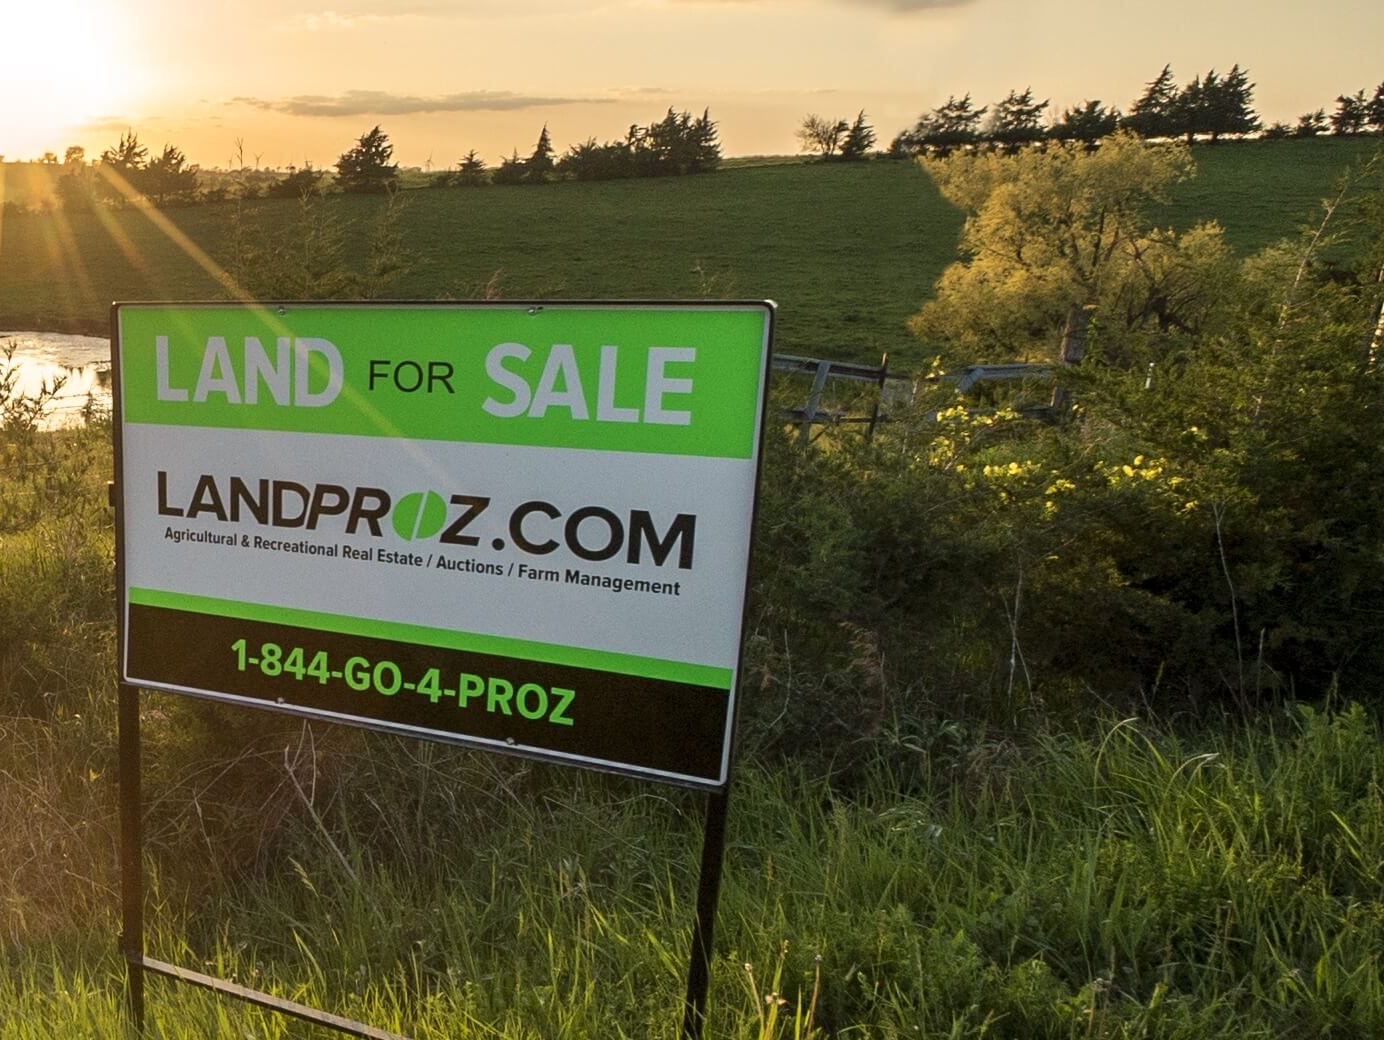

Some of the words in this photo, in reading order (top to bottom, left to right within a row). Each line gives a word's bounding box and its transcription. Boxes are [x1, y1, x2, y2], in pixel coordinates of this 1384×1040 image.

[154, 335, 345, 408] LAND
[368, 359, 456, 394] FOR
[482, 342, 697, 426] SALE
[165, 526, 237, 547] Agricultural
[241, 534, 250, 548] &
[253, 536, 338, 557] Recreational
[342, 545, 373, 561] Real
[377, 549, 423, 567] Estate
[436, 555, 503, 576] Auctions
[518, 564, 560, 582] Farm
[565, 569, 681, 596] Management
[230, 639, 577, 727] 1-844-GO-4-PROZ
